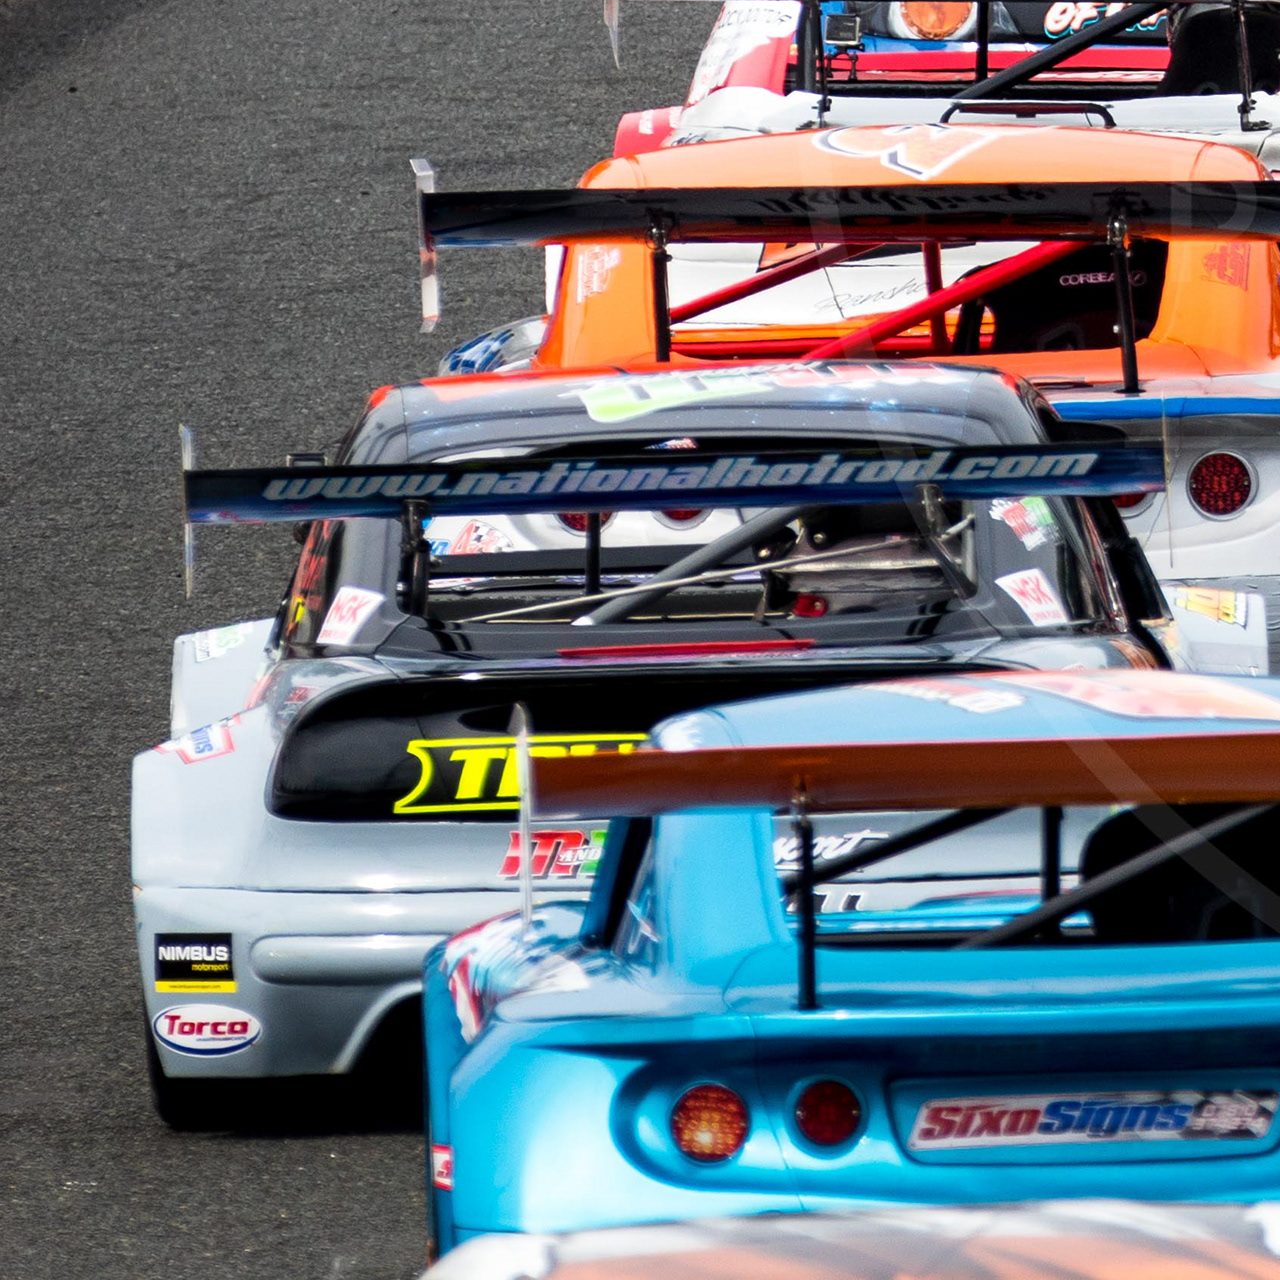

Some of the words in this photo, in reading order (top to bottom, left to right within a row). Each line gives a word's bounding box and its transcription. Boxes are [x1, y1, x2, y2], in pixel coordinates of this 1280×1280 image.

[262, 453, 1098, 501] www.nationalhotrod.com
[158, 946, 230, 961] NIMBUS
[164, 1015, 249, 1036] Torco
